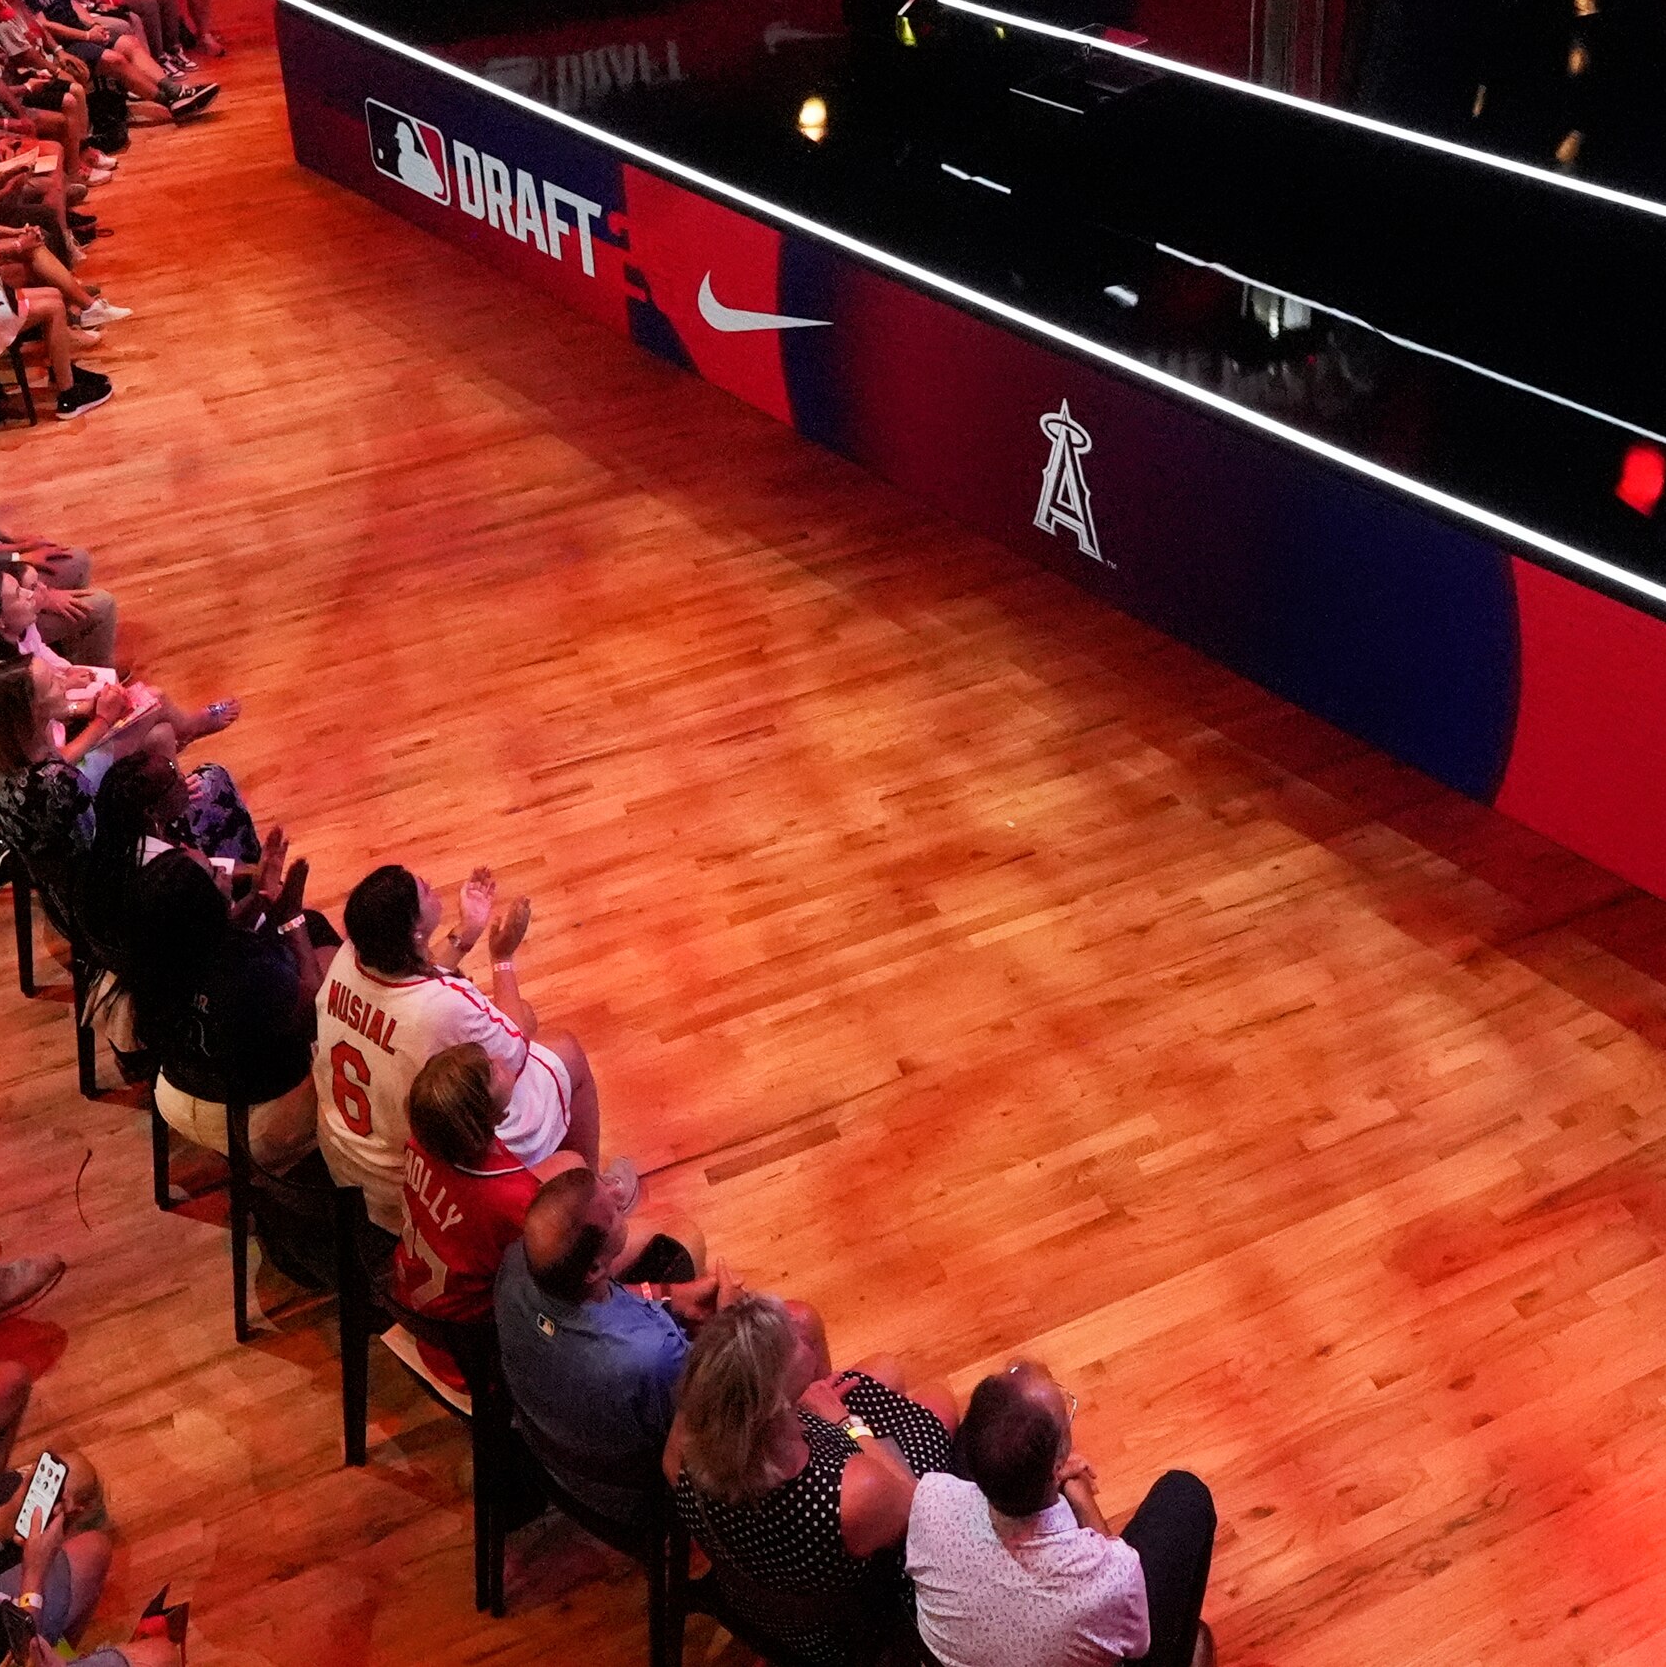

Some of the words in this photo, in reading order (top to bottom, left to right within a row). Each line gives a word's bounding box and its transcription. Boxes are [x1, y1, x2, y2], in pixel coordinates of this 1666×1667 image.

[452, 139, 602, 278] DRAFT
[327, 979, 397, 1056] MUSIAL
[330, 1040, 373, 1138] 6
